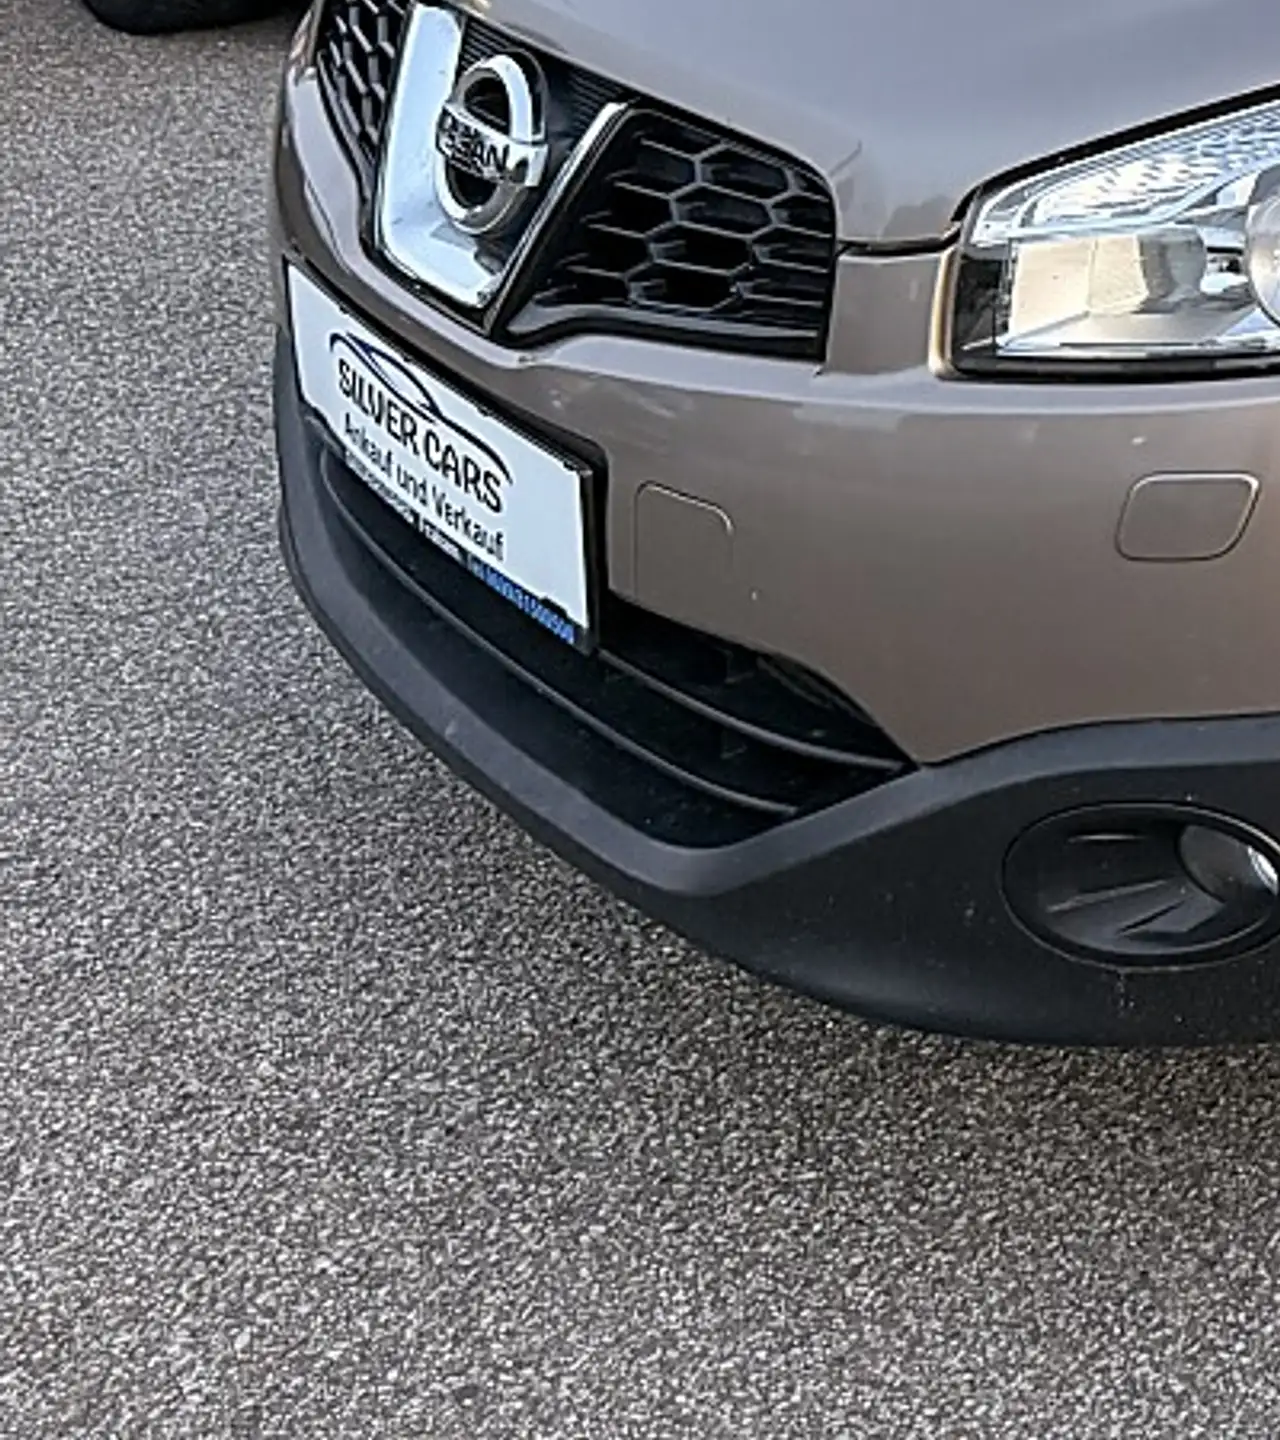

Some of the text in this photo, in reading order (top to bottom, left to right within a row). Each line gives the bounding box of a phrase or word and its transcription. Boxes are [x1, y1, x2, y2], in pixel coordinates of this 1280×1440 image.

[337, 358, 421, 457] SILVER
[423, 437, 503, 514] CARS
[396, 464, 428, 507] und
[431, 482, 504, 563] Verkauf
